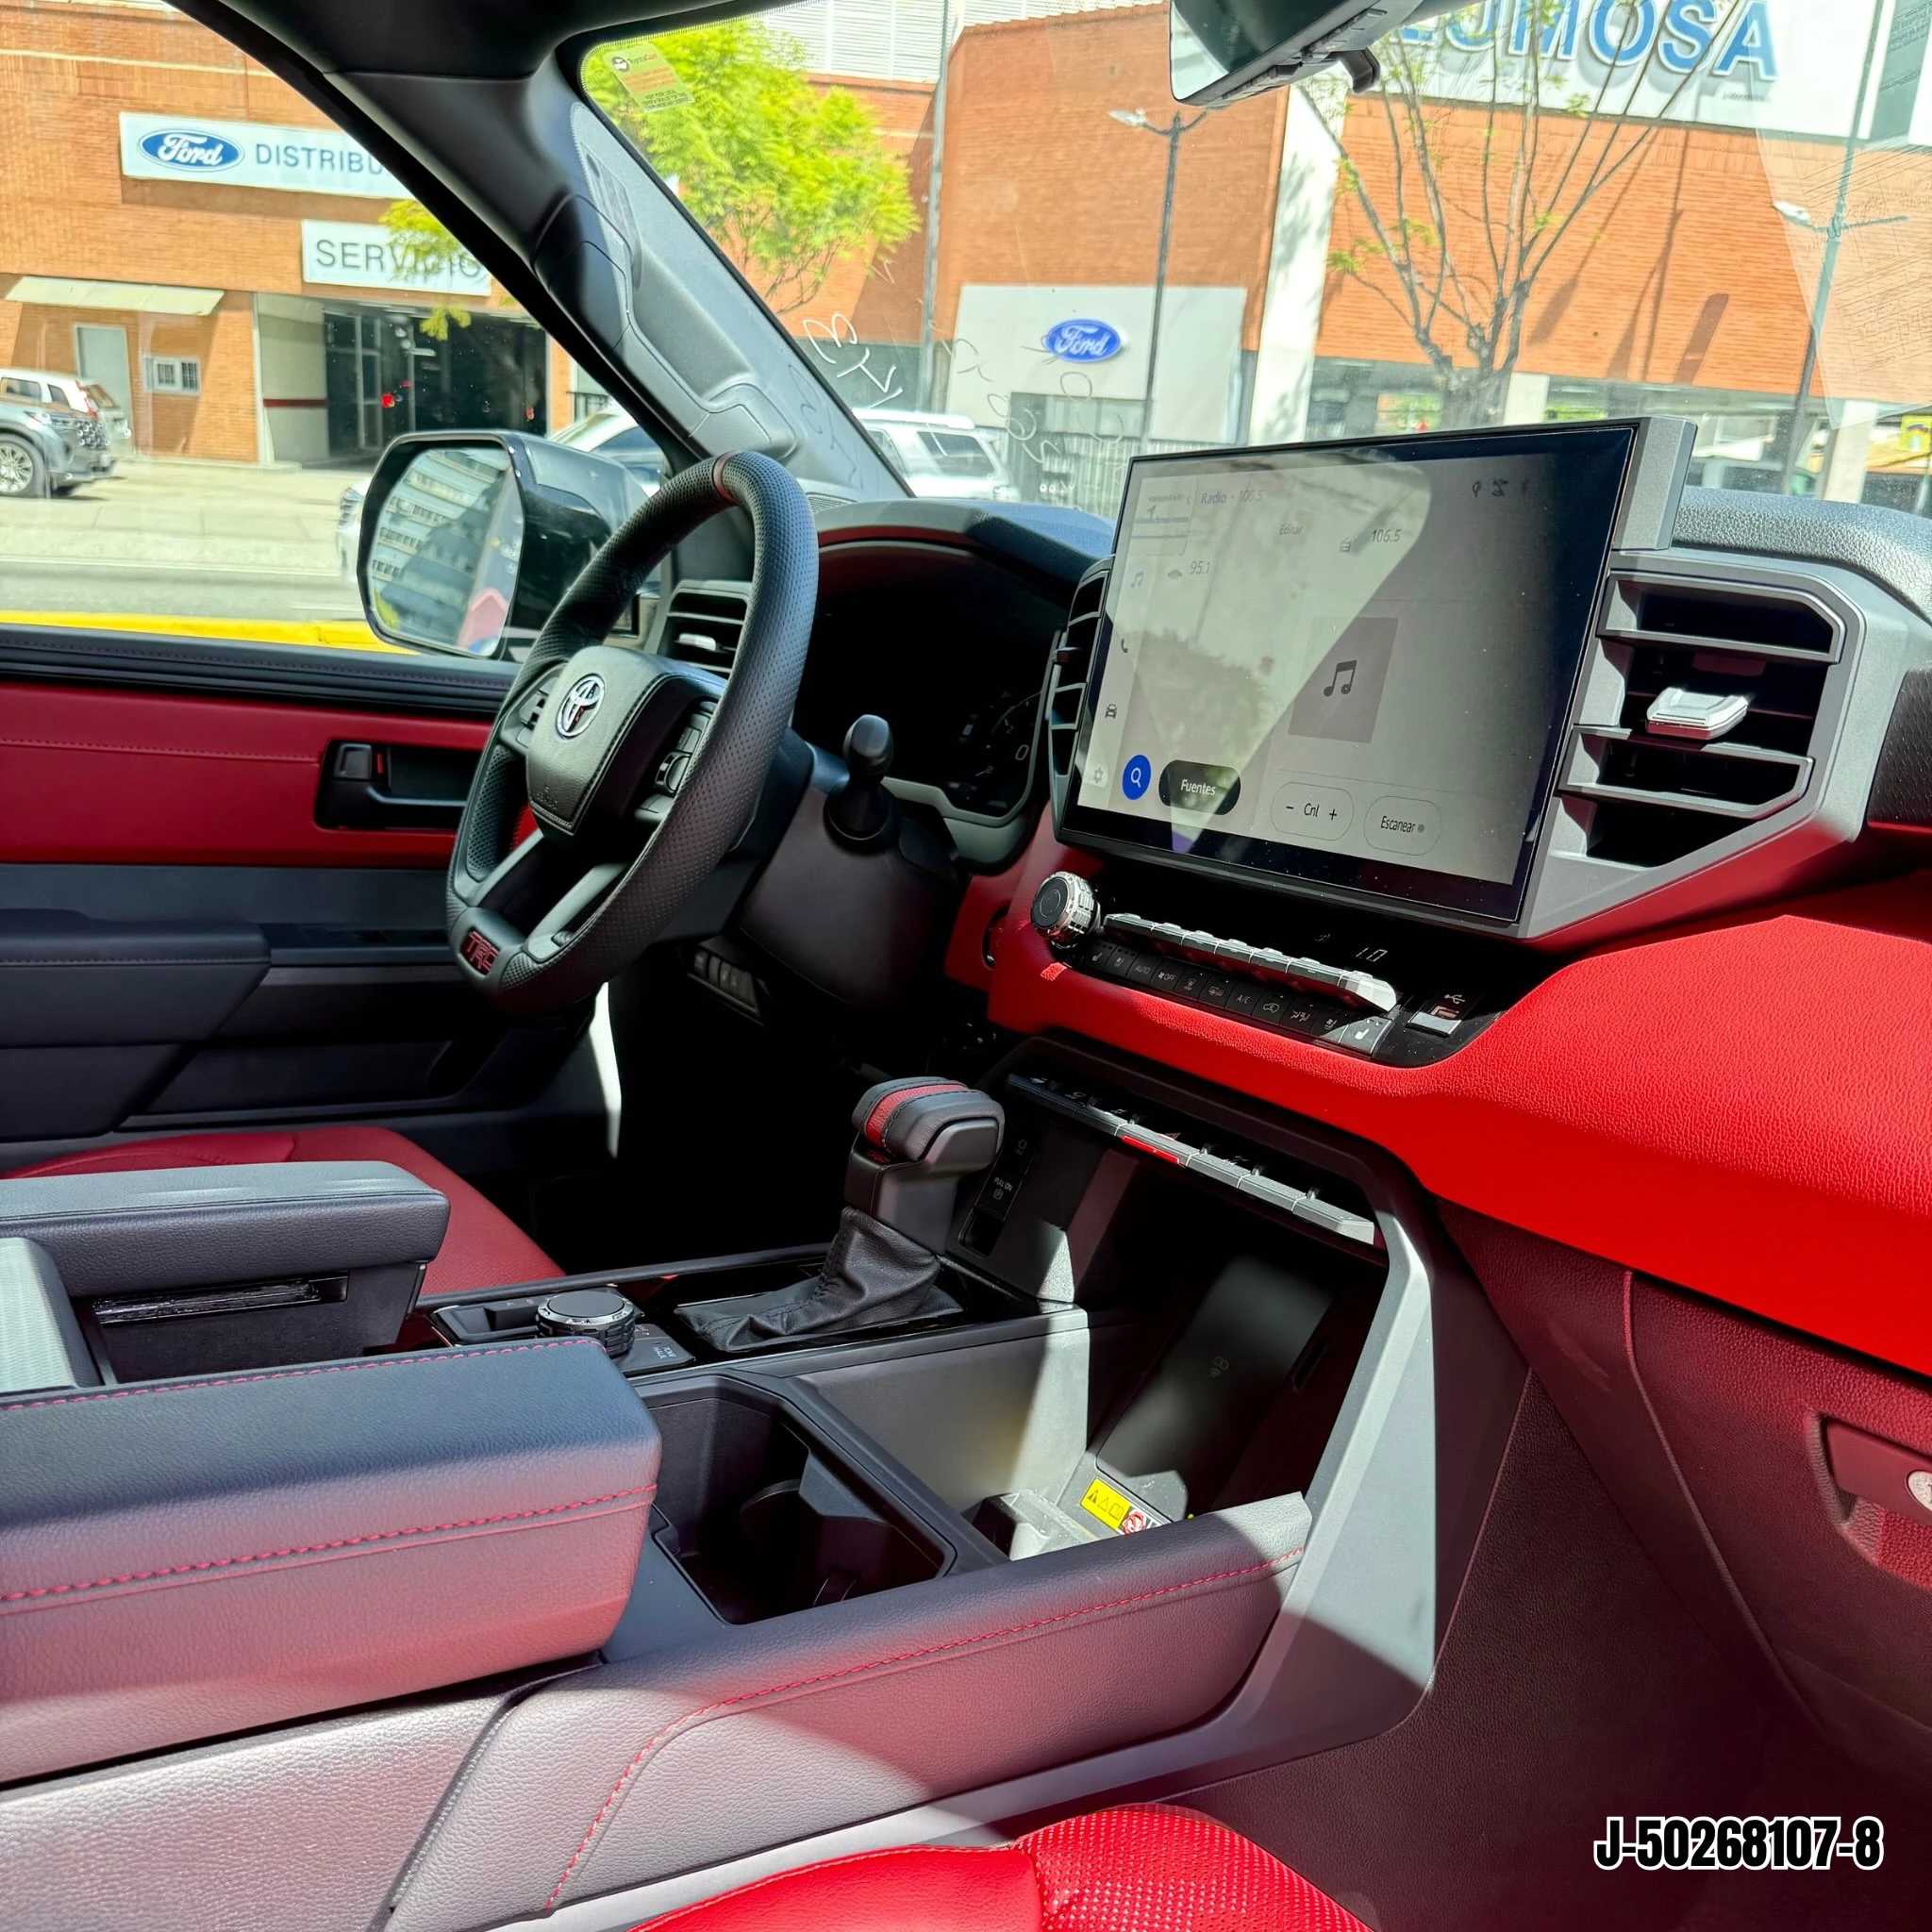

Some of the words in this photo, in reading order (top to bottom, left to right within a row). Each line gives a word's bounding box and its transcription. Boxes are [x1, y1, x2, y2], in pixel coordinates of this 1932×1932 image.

[158, 133, 224, 167] Ford
[1054, 325, 1111, 357] Ford
[1200, 491, 1226, 504] Radio
[1371, 528, 1403, 543] 106.5
[1190, 560, 1211, 575] 95.1
[1180, 778, 1216, 796] Fuentes
[1380, 815, 1415, 833] Escanear
[1236, 993, 1251, 1005] A/C
